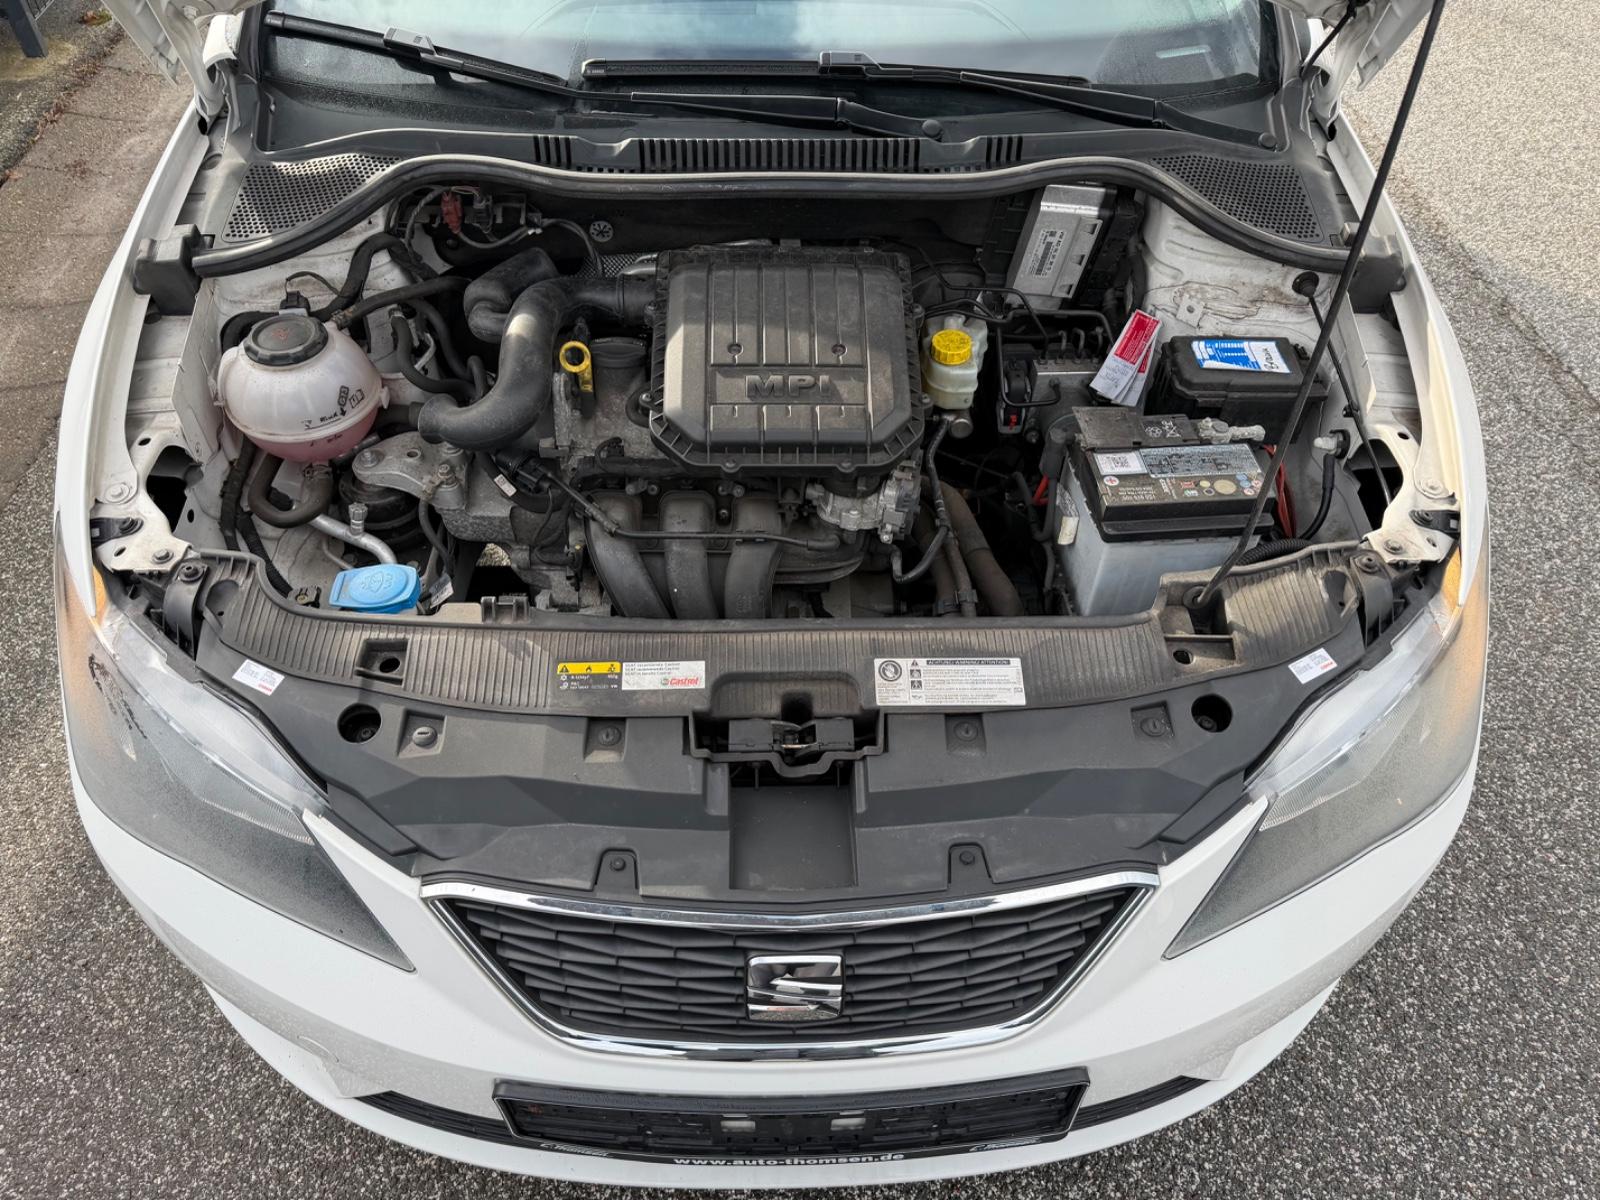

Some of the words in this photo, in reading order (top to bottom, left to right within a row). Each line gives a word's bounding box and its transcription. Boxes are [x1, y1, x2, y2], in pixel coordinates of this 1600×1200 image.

[745, 375, 830, 398] MPI
[669, 677, 699, 686] Castrol
[673, 1153, 905, 1166] www.auto-thomsen.de
